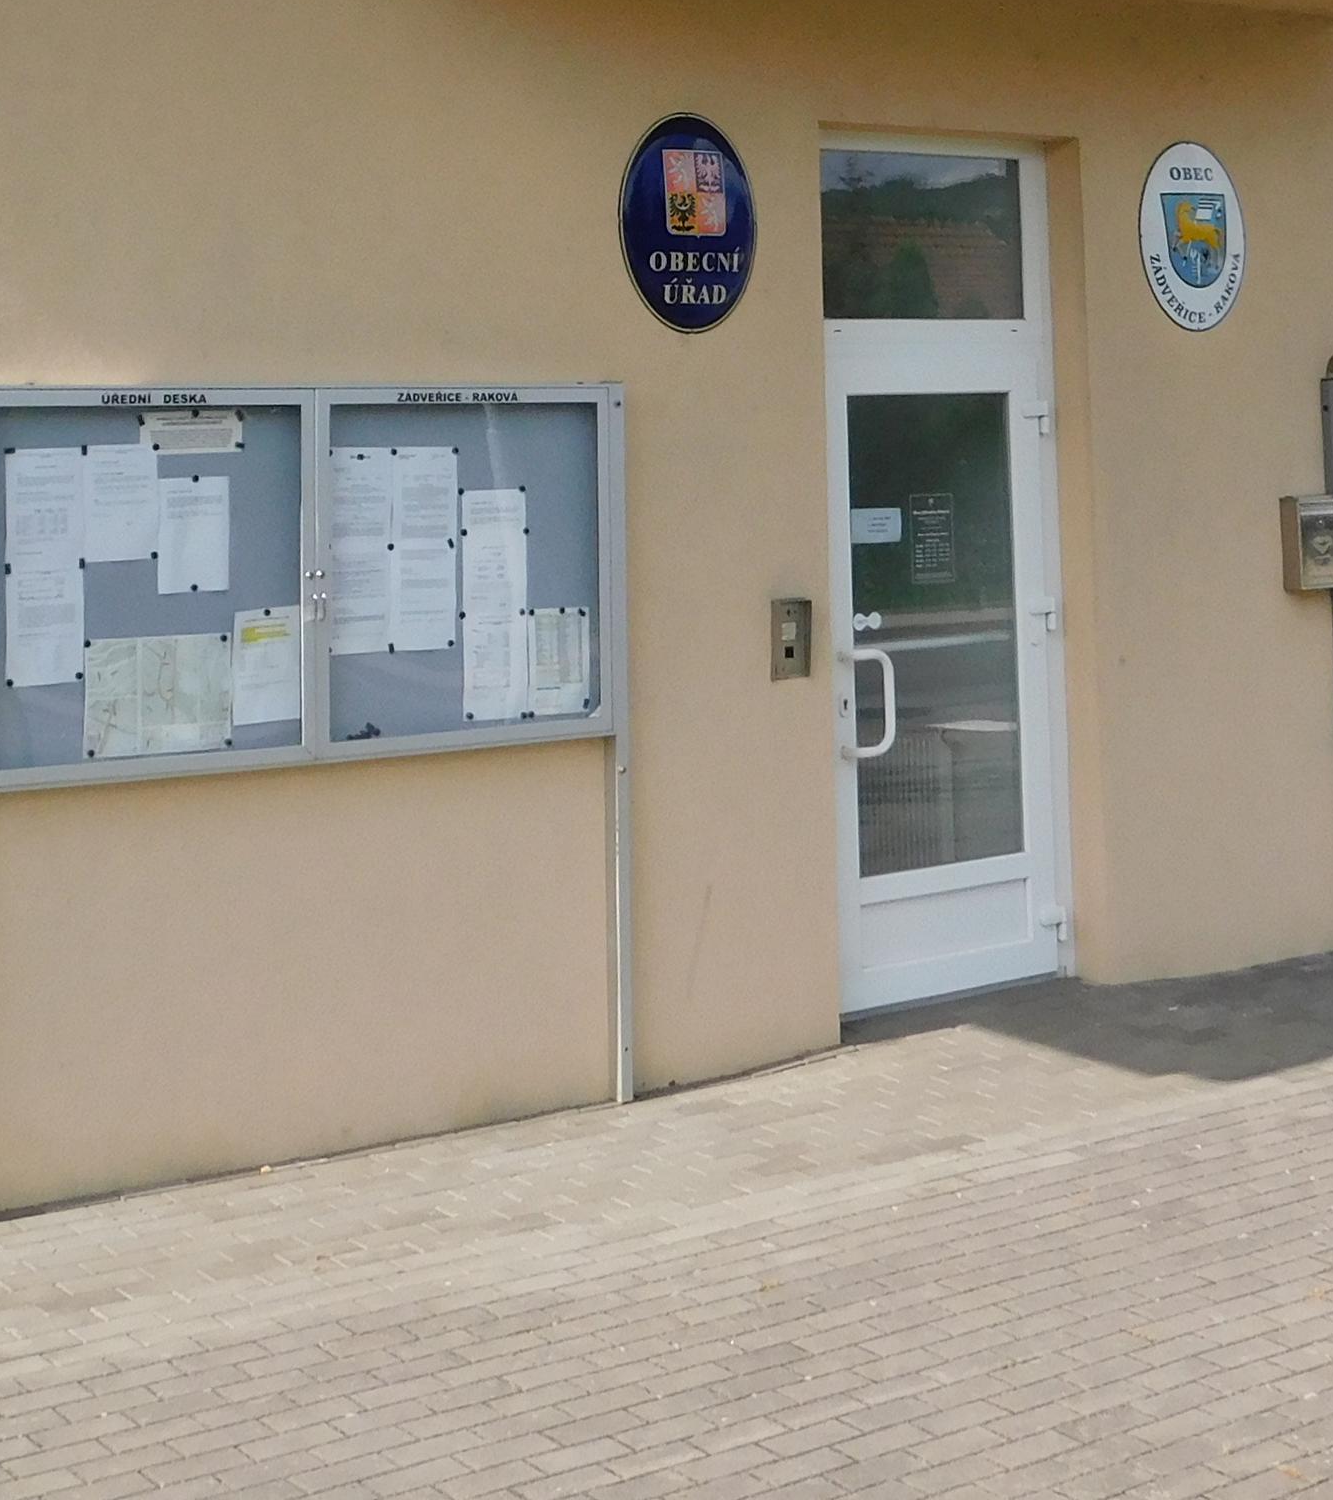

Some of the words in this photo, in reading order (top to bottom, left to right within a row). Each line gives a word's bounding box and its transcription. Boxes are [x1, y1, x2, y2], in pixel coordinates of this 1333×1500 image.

[1169, 166, 1214, 181] OBEC
[649, 247, 739, 273] OBECNÍ
[662, 277, 727, 305] ÚŘAD
[1149, 253, 1207, 324] ZÁDVEŘICE
[101, 392, 152, 405] ÚŘEDNÍ
[163, 393, 207, 404] DESKA
